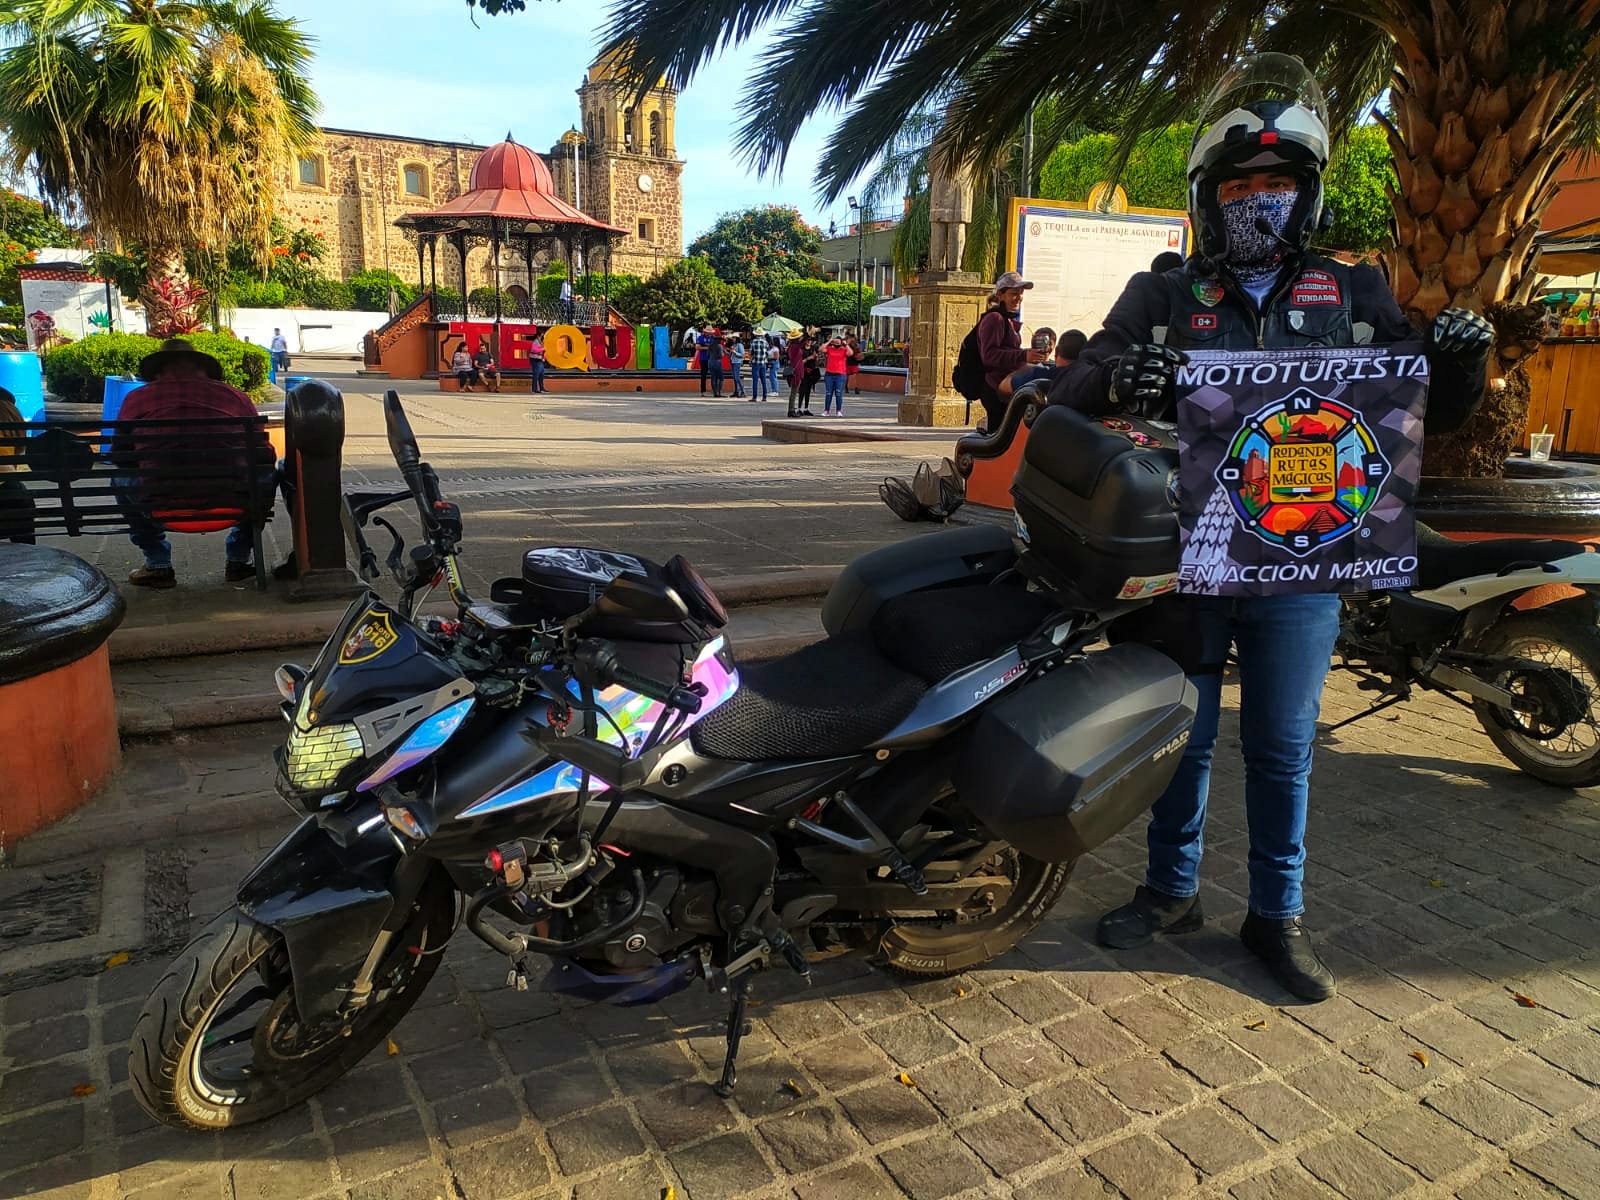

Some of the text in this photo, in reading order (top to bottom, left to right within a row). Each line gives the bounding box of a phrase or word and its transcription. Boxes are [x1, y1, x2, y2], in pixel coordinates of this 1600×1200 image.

[1044, 222, 1080, 233] TEQUILA
[1100, 225, 1130, 237] PAISAJE
[1130, 229, 1167, 239] AGAVERO
[449, 322, 702, 373] TEQUIL
[1175, 354, 1429, 387] MOTOTURISTA
[1294, 398, 1311, 409] N
[1368, 463, 1383, 476] E
[1294, 534, 1310, 547] S
[1178, 556, 1419, 583] EN ACCIÓN MÉXICO
[363, 626, 386, 649] 016
[372, 621, 391, 639] PILOTO
[1152, 730, 1190, 762] SHAD
